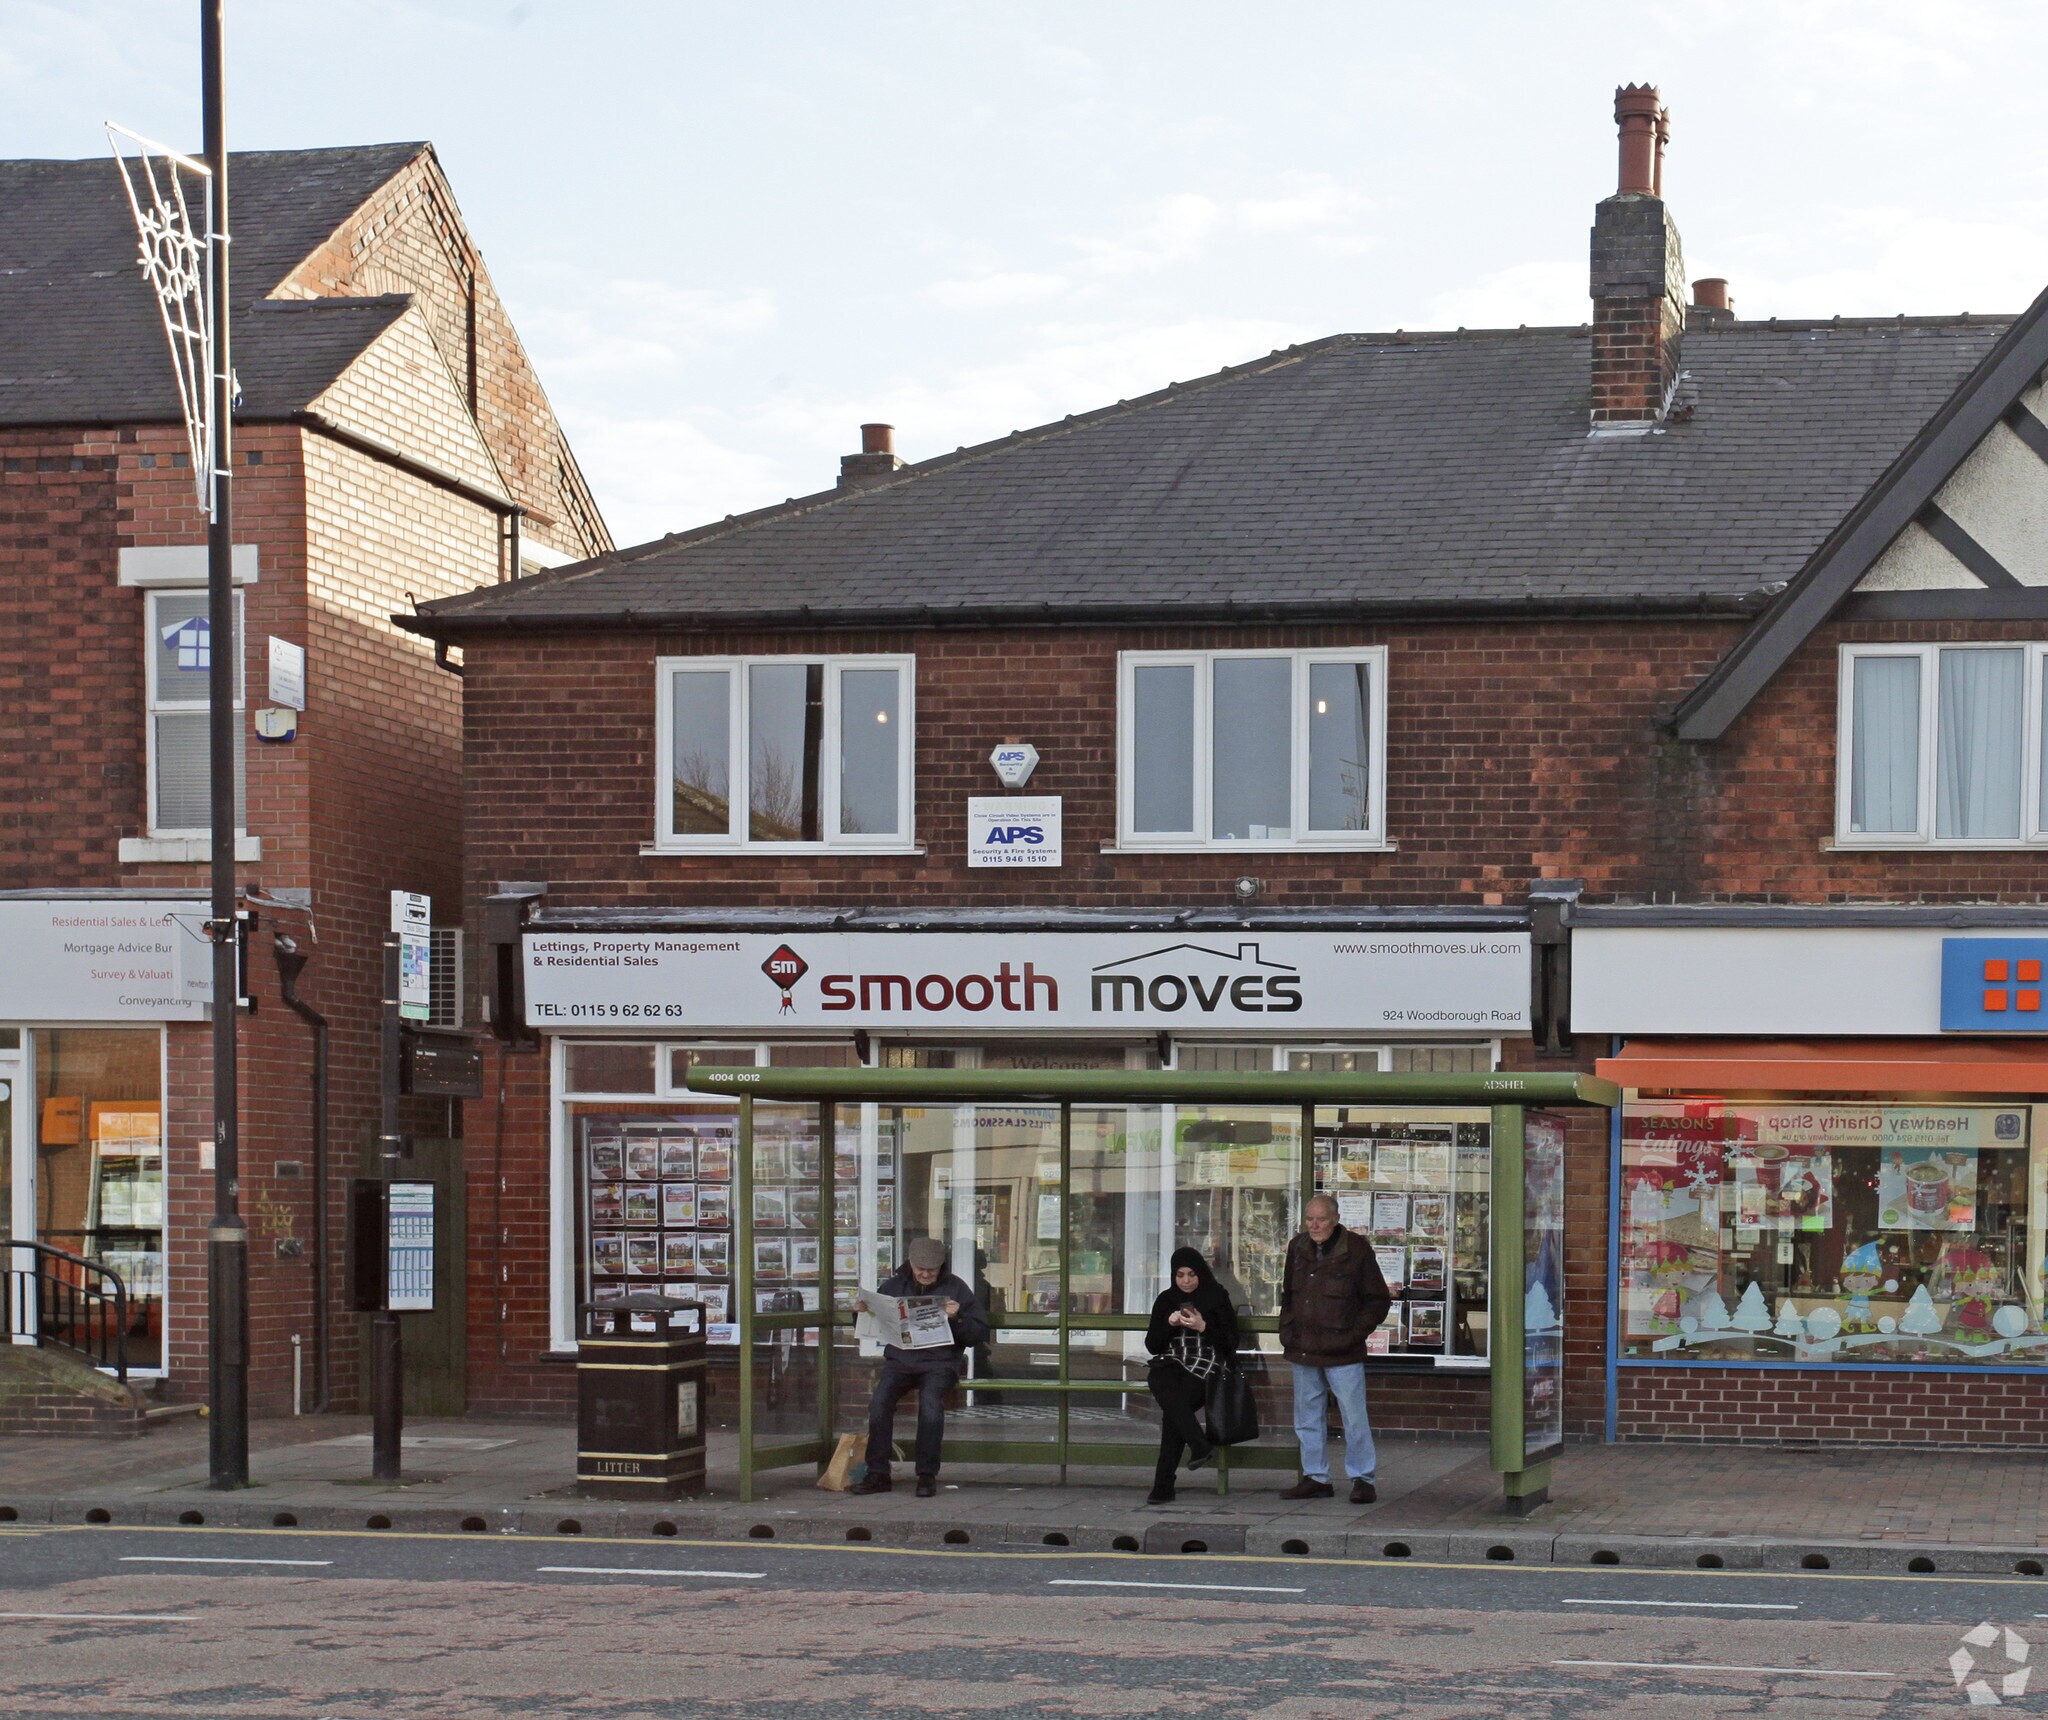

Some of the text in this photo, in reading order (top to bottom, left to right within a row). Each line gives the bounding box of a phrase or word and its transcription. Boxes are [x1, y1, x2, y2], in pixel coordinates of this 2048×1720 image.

[997, 752, 1025, 761] APS
[985, 826, 1045, 845] APS
[982, 855, 1047, 863] 0115 946 1510
[52, 917, 108, 927] Residential
[111, 917, 137, 927] Sales
[139, 917, 147, 927] &
[64, 943, 115, 955] Mortgage
[117, 943, 153, 953] Advice
[532, 941, 740, 954] Lettings, Property Management
[1333, 941, 1522, 955] www.smoothmoves.uk.com
[533, 956, 659, 966] & Residential Sales
[91, 970, 125, 981] Survey
[128, 970, 136, 979] &
[820, 962, 1058, 1011] smooth
[535, 1003, 683, 1017] TEL: 0115 9 62 62 63
[1383, 1010, 1522, 1024] 924 Woodborough Road
[708, 1073, 761, 1082] 4004 0012
[1483, 1080, 1526, 1090] ADSHEL
[1640, 1131, 1714, 1162] Eatings
[597, 1461, 641, 1473] LITTER
